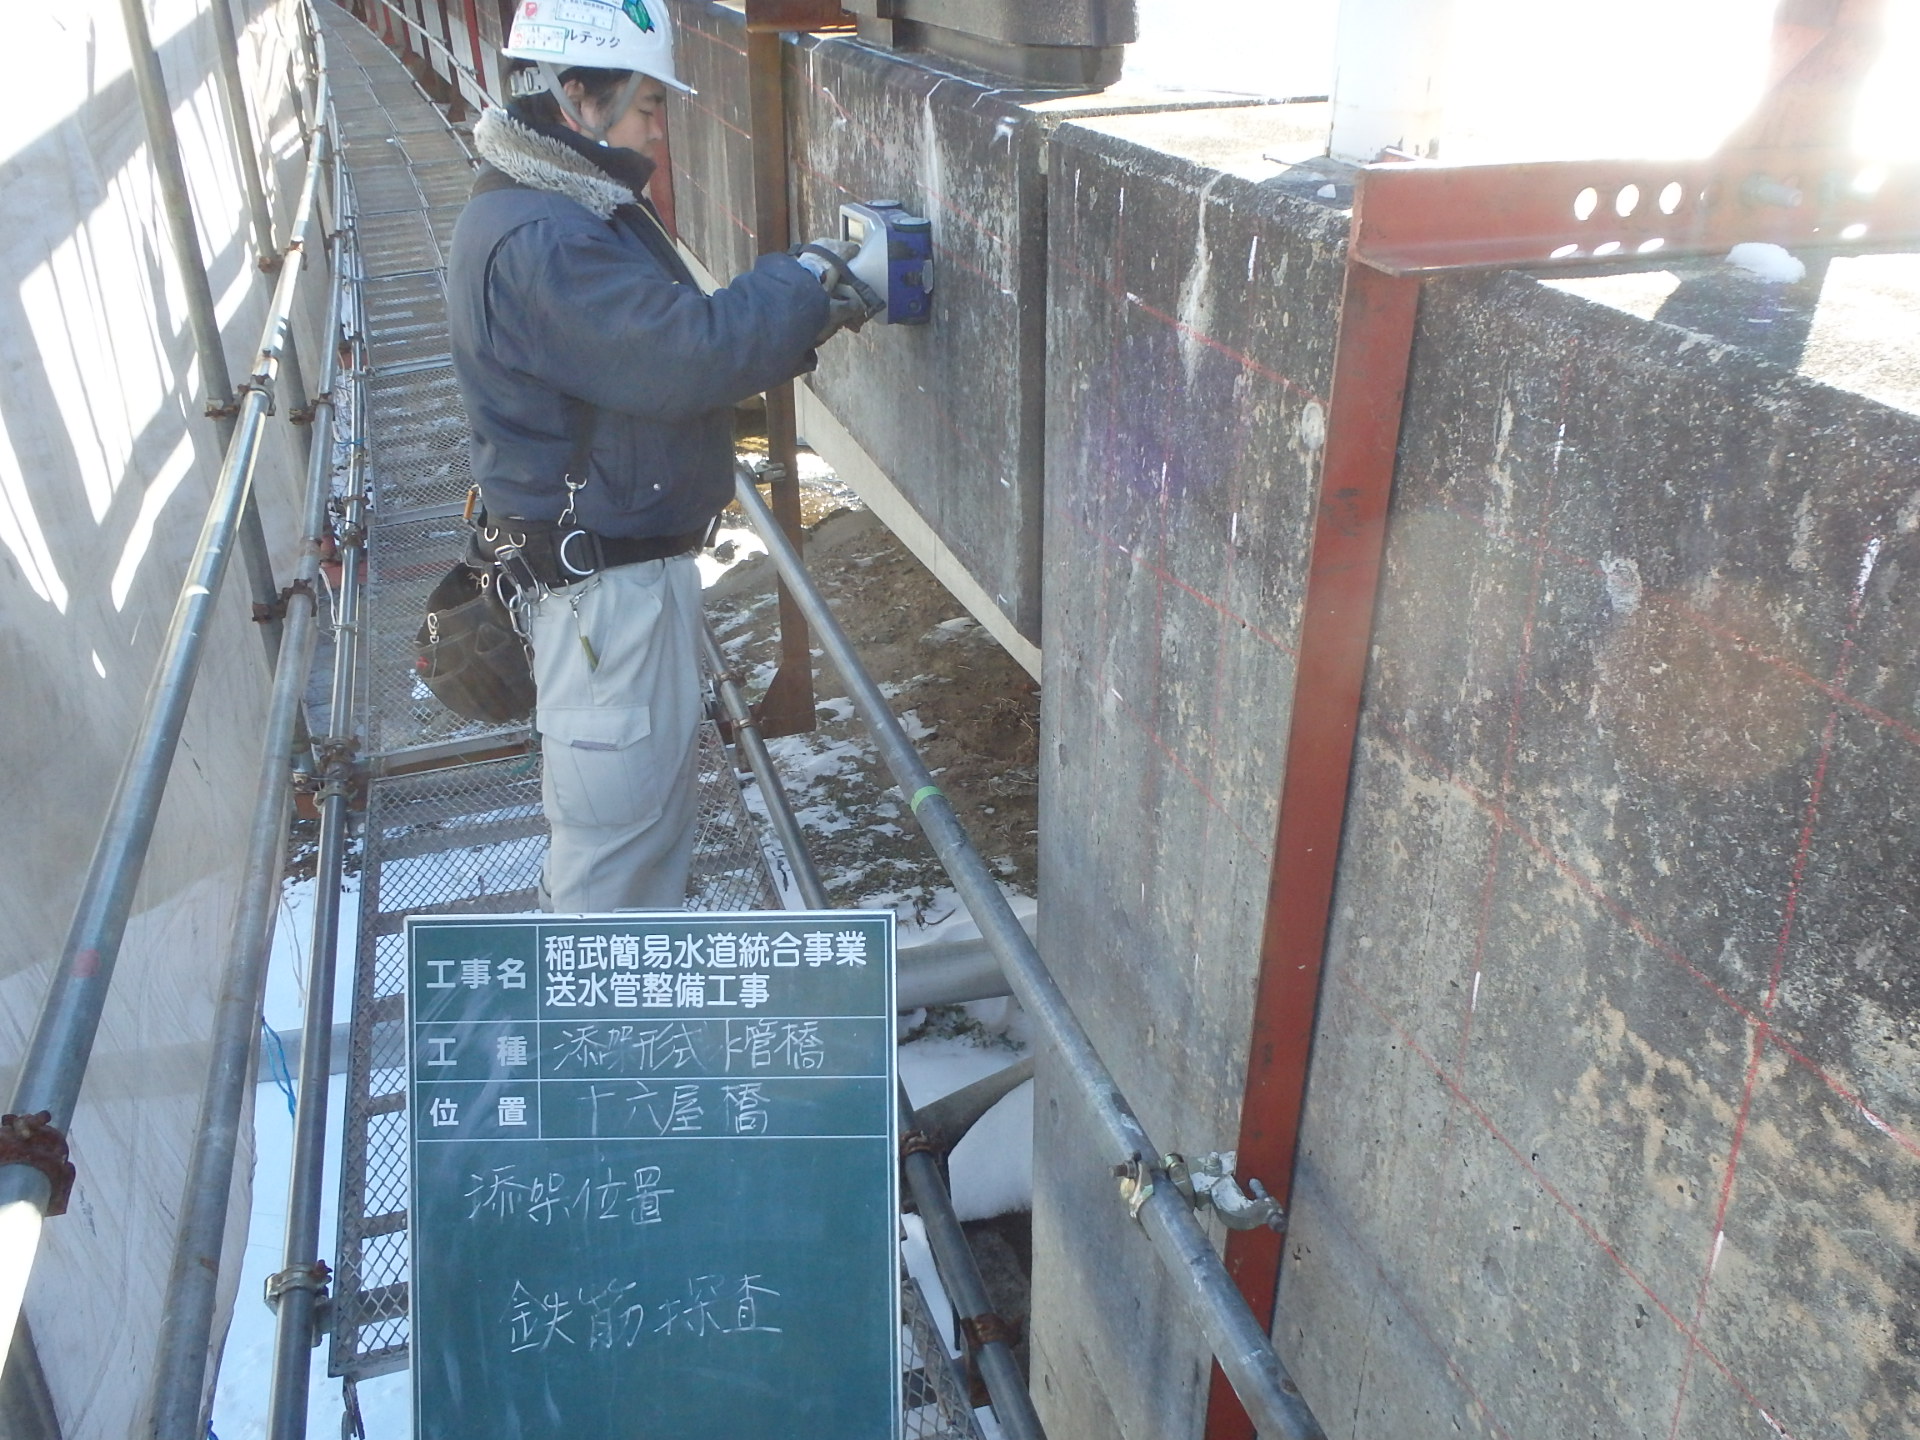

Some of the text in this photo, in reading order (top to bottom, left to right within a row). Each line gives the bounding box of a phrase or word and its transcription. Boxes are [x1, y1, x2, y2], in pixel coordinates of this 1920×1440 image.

[545, 931, 868, 967] 稲武簡易水道統合事業
[425, 957, 528, 991] 工事名
[545, 971, 770, 1009] 送水管整備工事
[427, 1036, 528, 1068] 工種
[429, 1096, 528, 1128] 位置
[464, 1164, 675, 1226] 添架位置
